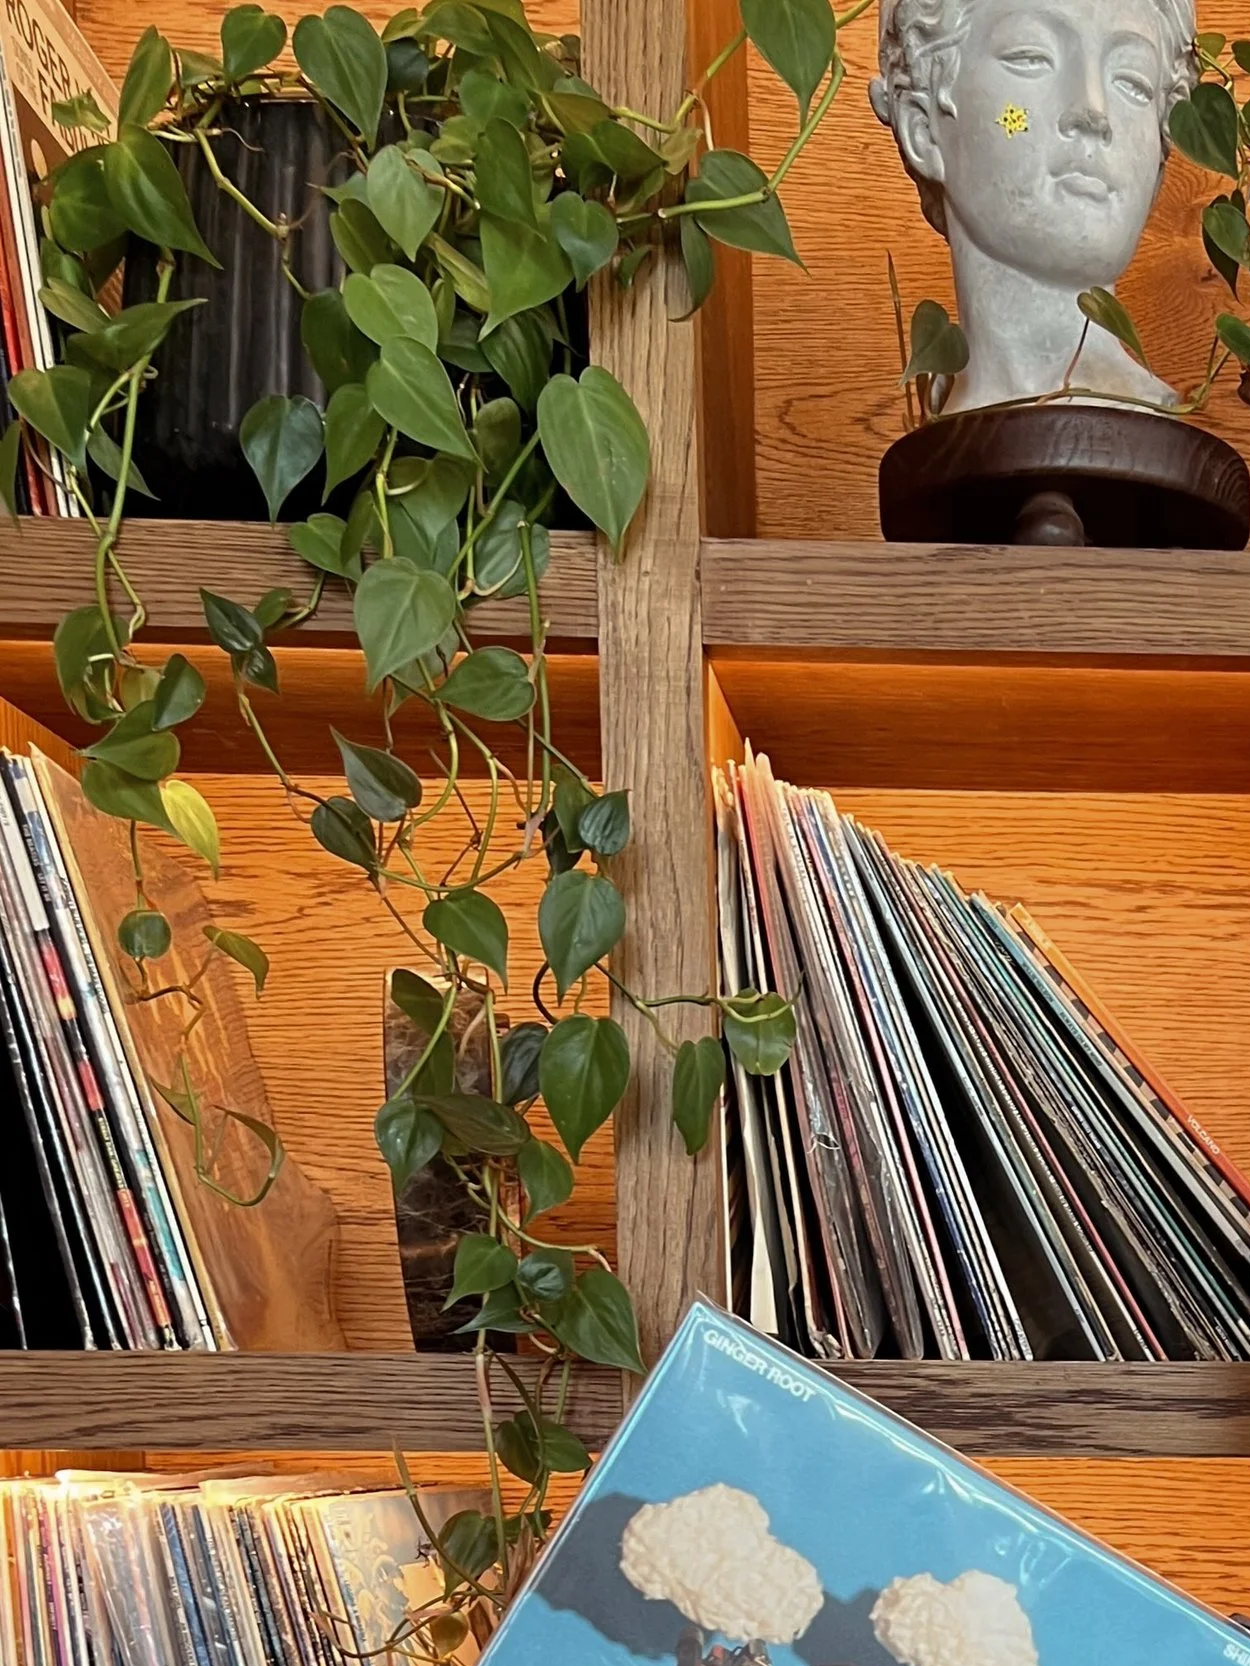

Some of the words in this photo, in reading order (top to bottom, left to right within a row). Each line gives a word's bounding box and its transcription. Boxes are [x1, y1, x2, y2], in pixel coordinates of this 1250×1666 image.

[1186, 1114, 1221, 1156] VOLCANO
[703, 1328, 769, 1376] GINGER
[766, 1368, 817, 1403] ROOT
